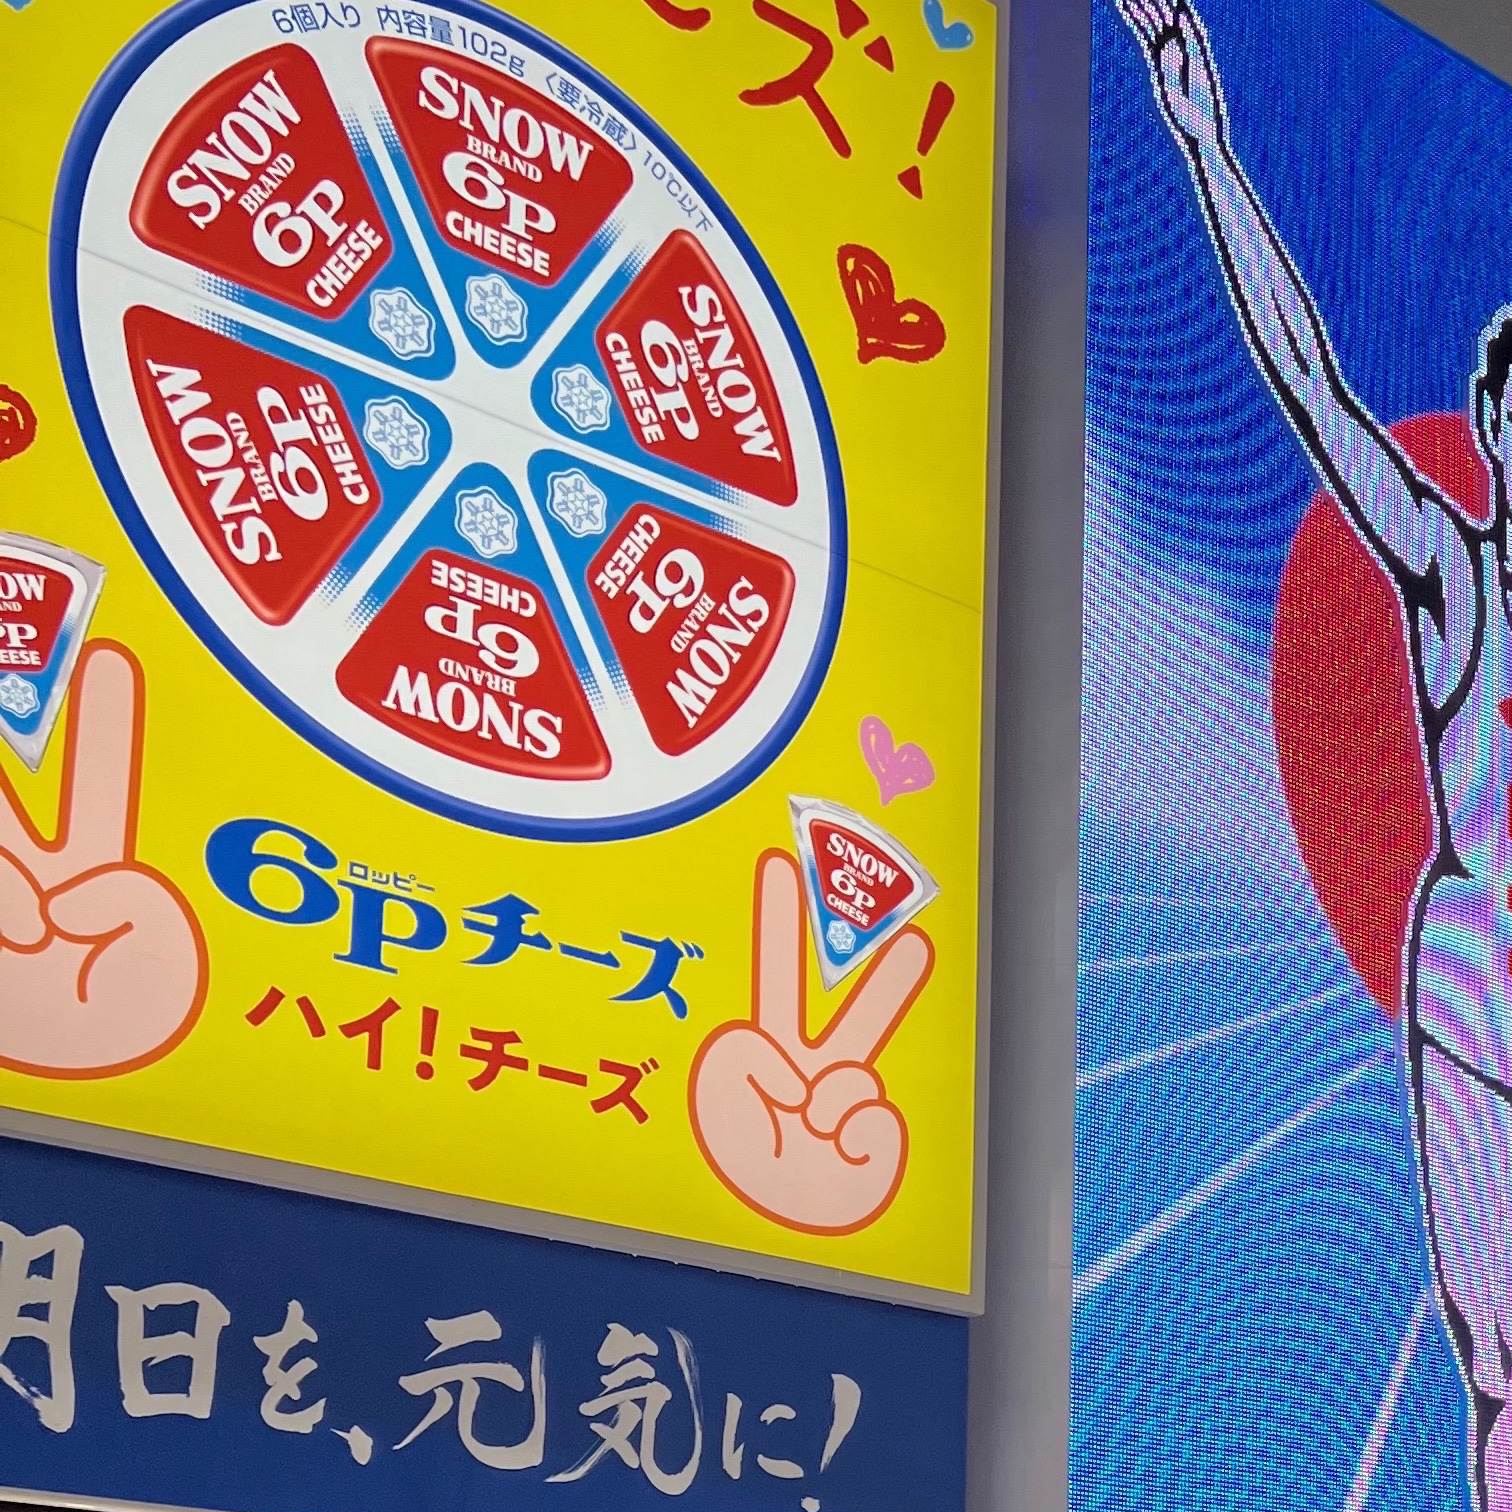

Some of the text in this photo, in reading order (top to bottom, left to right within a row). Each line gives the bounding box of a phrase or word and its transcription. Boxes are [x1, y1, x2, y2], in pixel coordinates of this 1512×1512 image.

[272, 2, 361, 34] 6個入り
[376, 4, 526, 78] 内容量102g
[167, 68, 303, 231] SNOW
[418, 65, 595, 183] SNOW
[465, 135, 544, 185] BRAND
[238, 151, 296, 217] BRAND
[251, 177, 350, 270] 6P
[443, 153, 557, 241] 6P
[306, 219, 387, 310] CHEESE
[445, 213, 551, 277] CHEESE
[604, 331, 665, 445] CHEESE
[643, 320, 701, 444] 6P
[678, 282, 783, 466] SNOW
[683, 339, 725, 420] BRAND
[145, 357, 283, 569] SNOW
[223, 409, 275, 504] BRAND
[256, 383, 331, 523] 6P
[298, 381, 370, 509] CHEESE
[430, 557, 539, 615] CHEESE
[593, 511, 663, 600] CHEESE
[627, 546, 706, 636] 6P
[424, 596, 544, 680] 6P
[666, 576, 771, 731] SNOW
[669, 589, 718, 653] BRAND
[382, 664, 565, 760] SNOW
[437, 655, 518, 698] BRAND
[348, 860, 436, 894] ロッピー
[826, 833, 899, 888] SNOW
[831, 869, 876, 911] 6P
[827, 893, 870, 926] CHEESE
